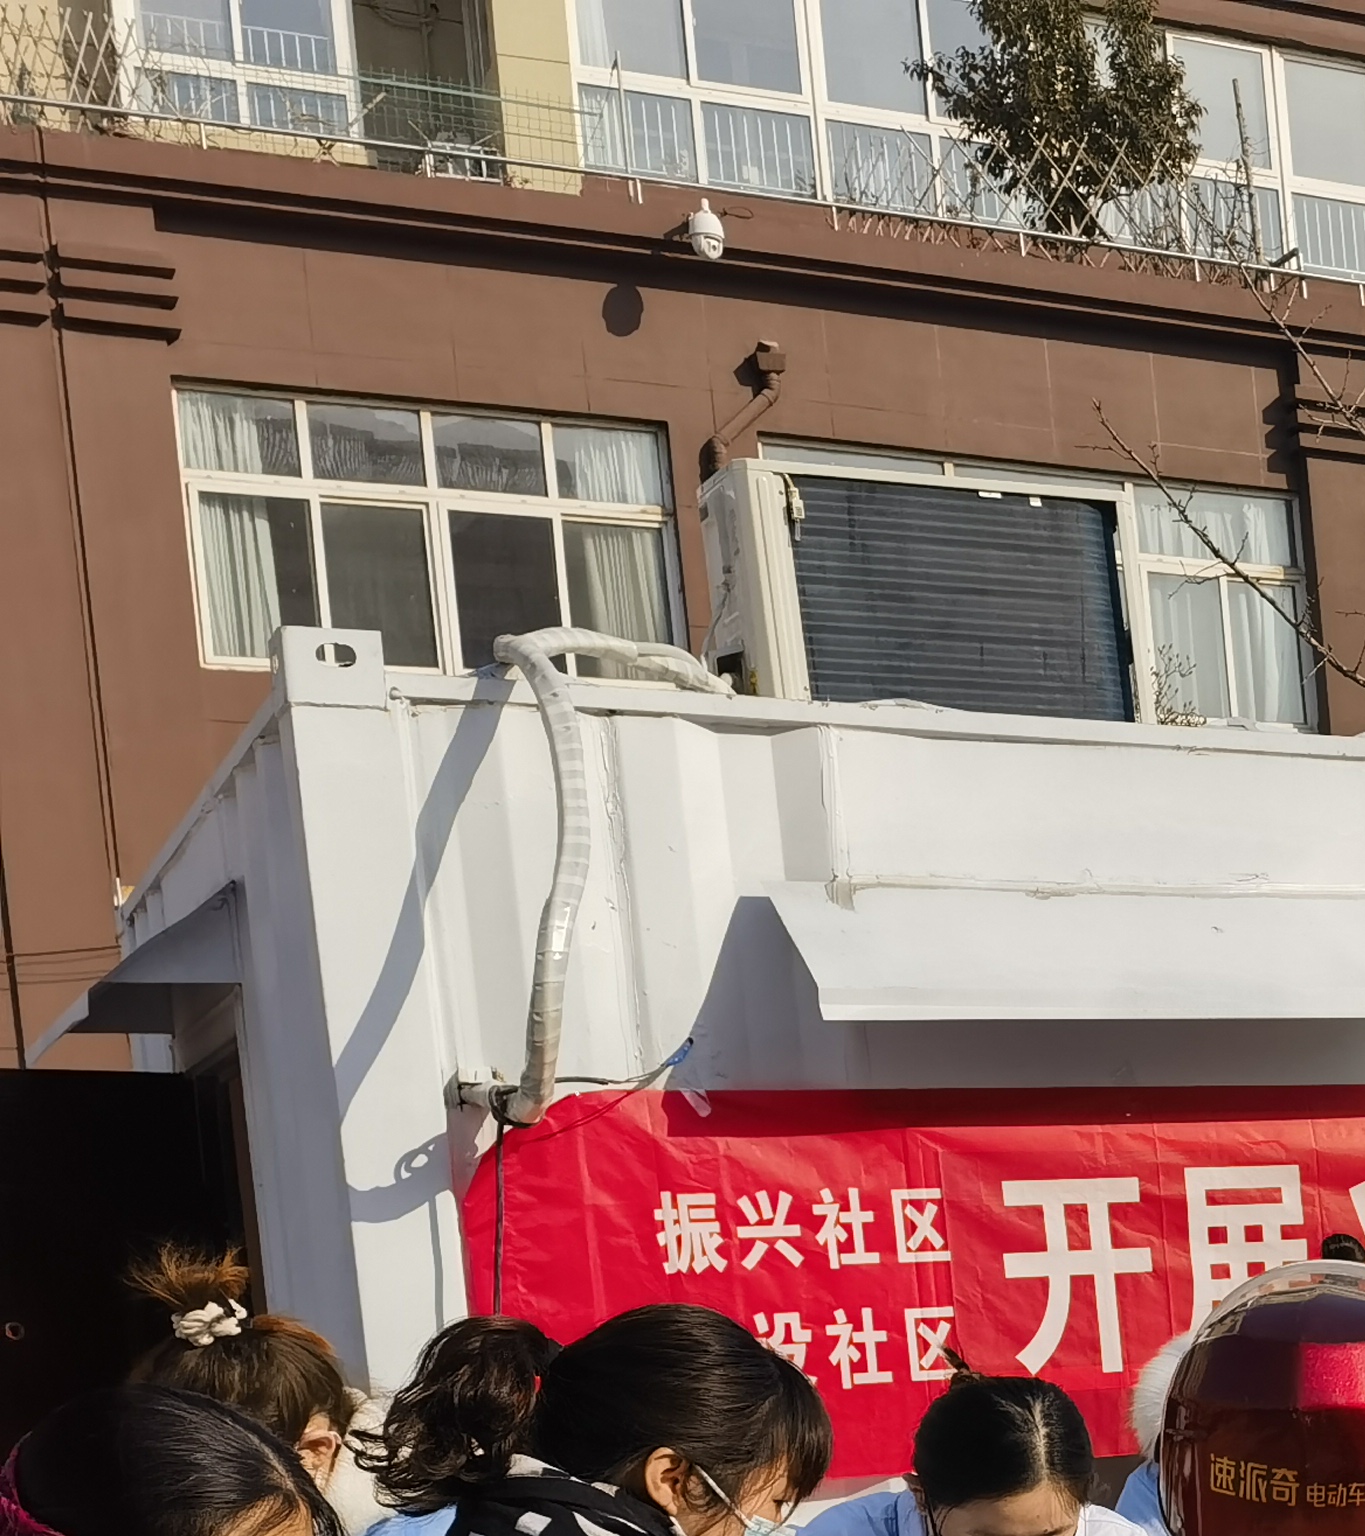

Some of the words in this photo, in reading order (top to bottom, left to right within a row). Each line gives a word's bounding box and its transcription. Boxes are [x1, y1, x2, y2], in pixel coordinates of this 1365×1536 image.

[653, 1187, 952, 1275] 振兴社区
[1210, 1453, 1300, 1507] 速派奇
